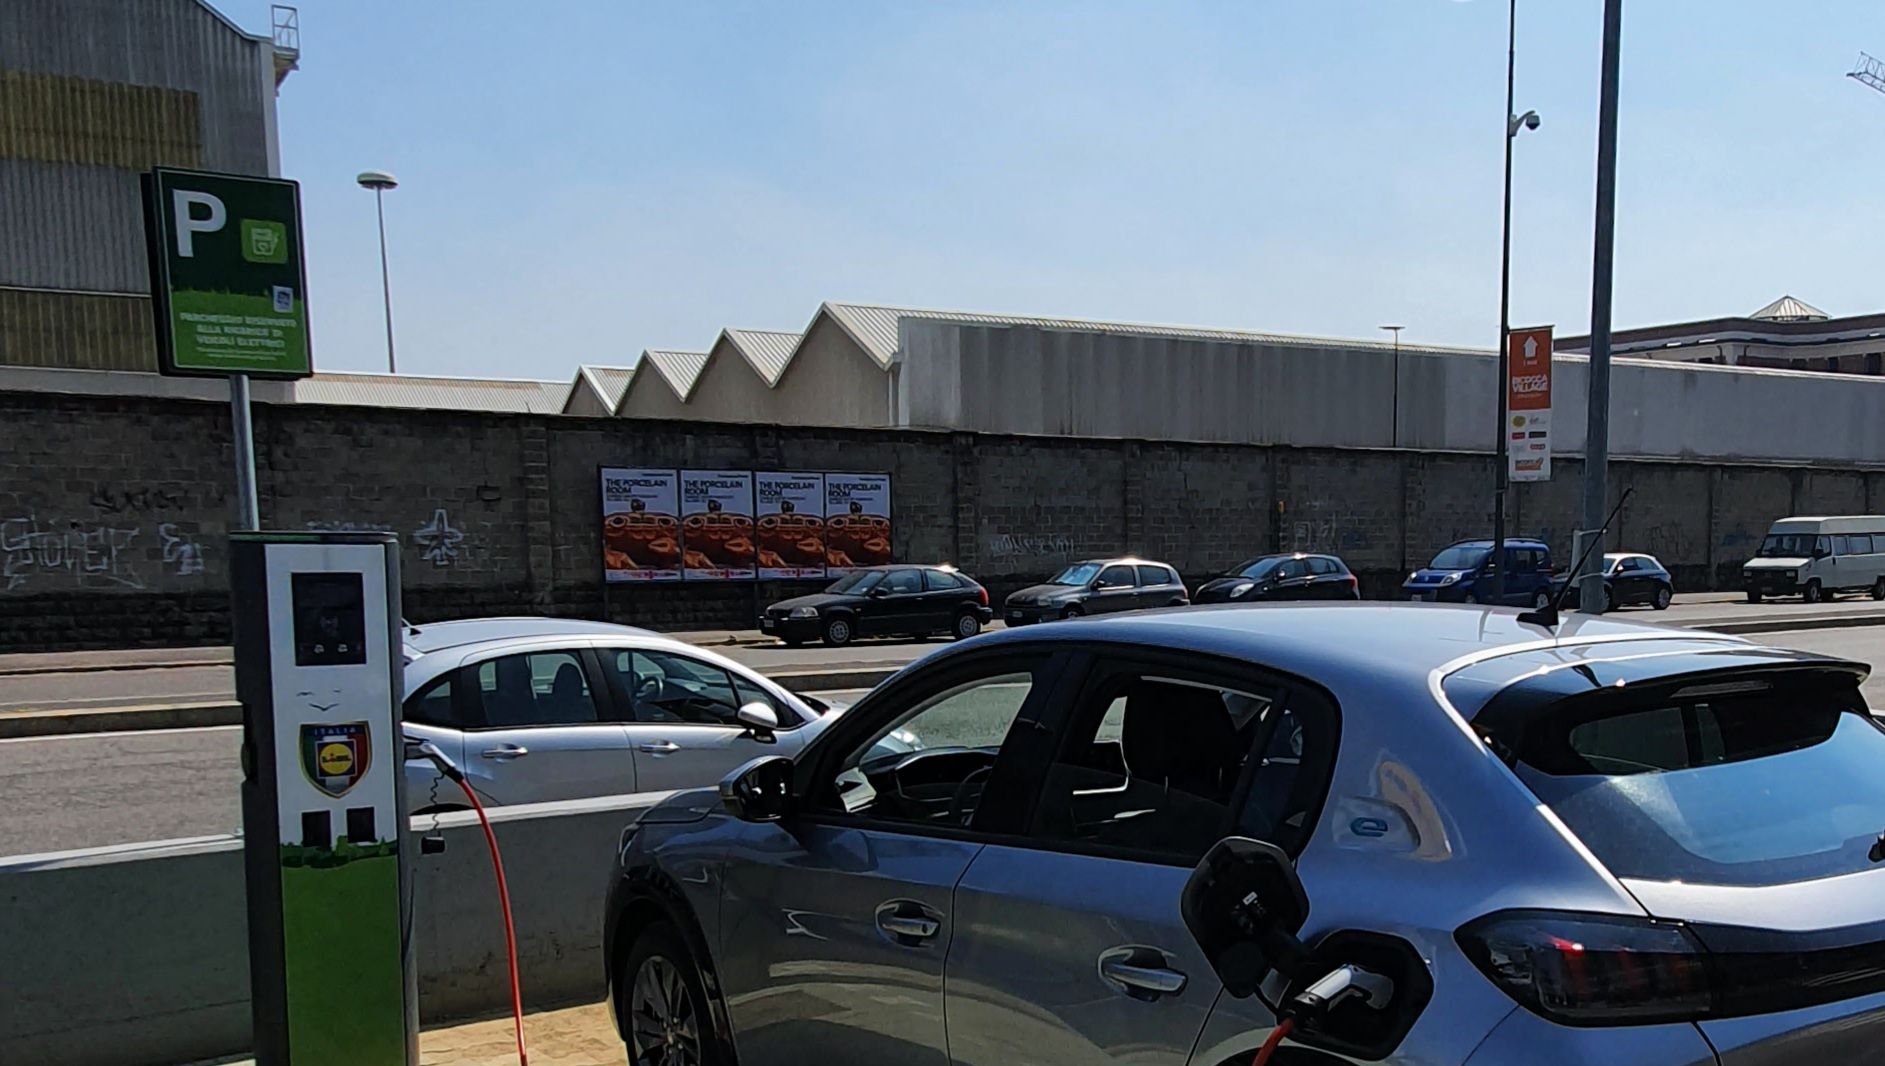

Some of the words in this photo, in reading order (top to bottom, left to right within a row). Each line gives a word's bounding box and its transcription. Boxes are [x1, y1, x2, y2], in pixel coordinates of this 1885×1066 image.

[172, 188, 227, 258] P
[606, 478, 621, 487] THE
[684, 480, 699, 488] THE
[759, 481, 774, 489] THE
[828, 482, 843, 491] THE
[315, 727, 356, 736] ITALIA
